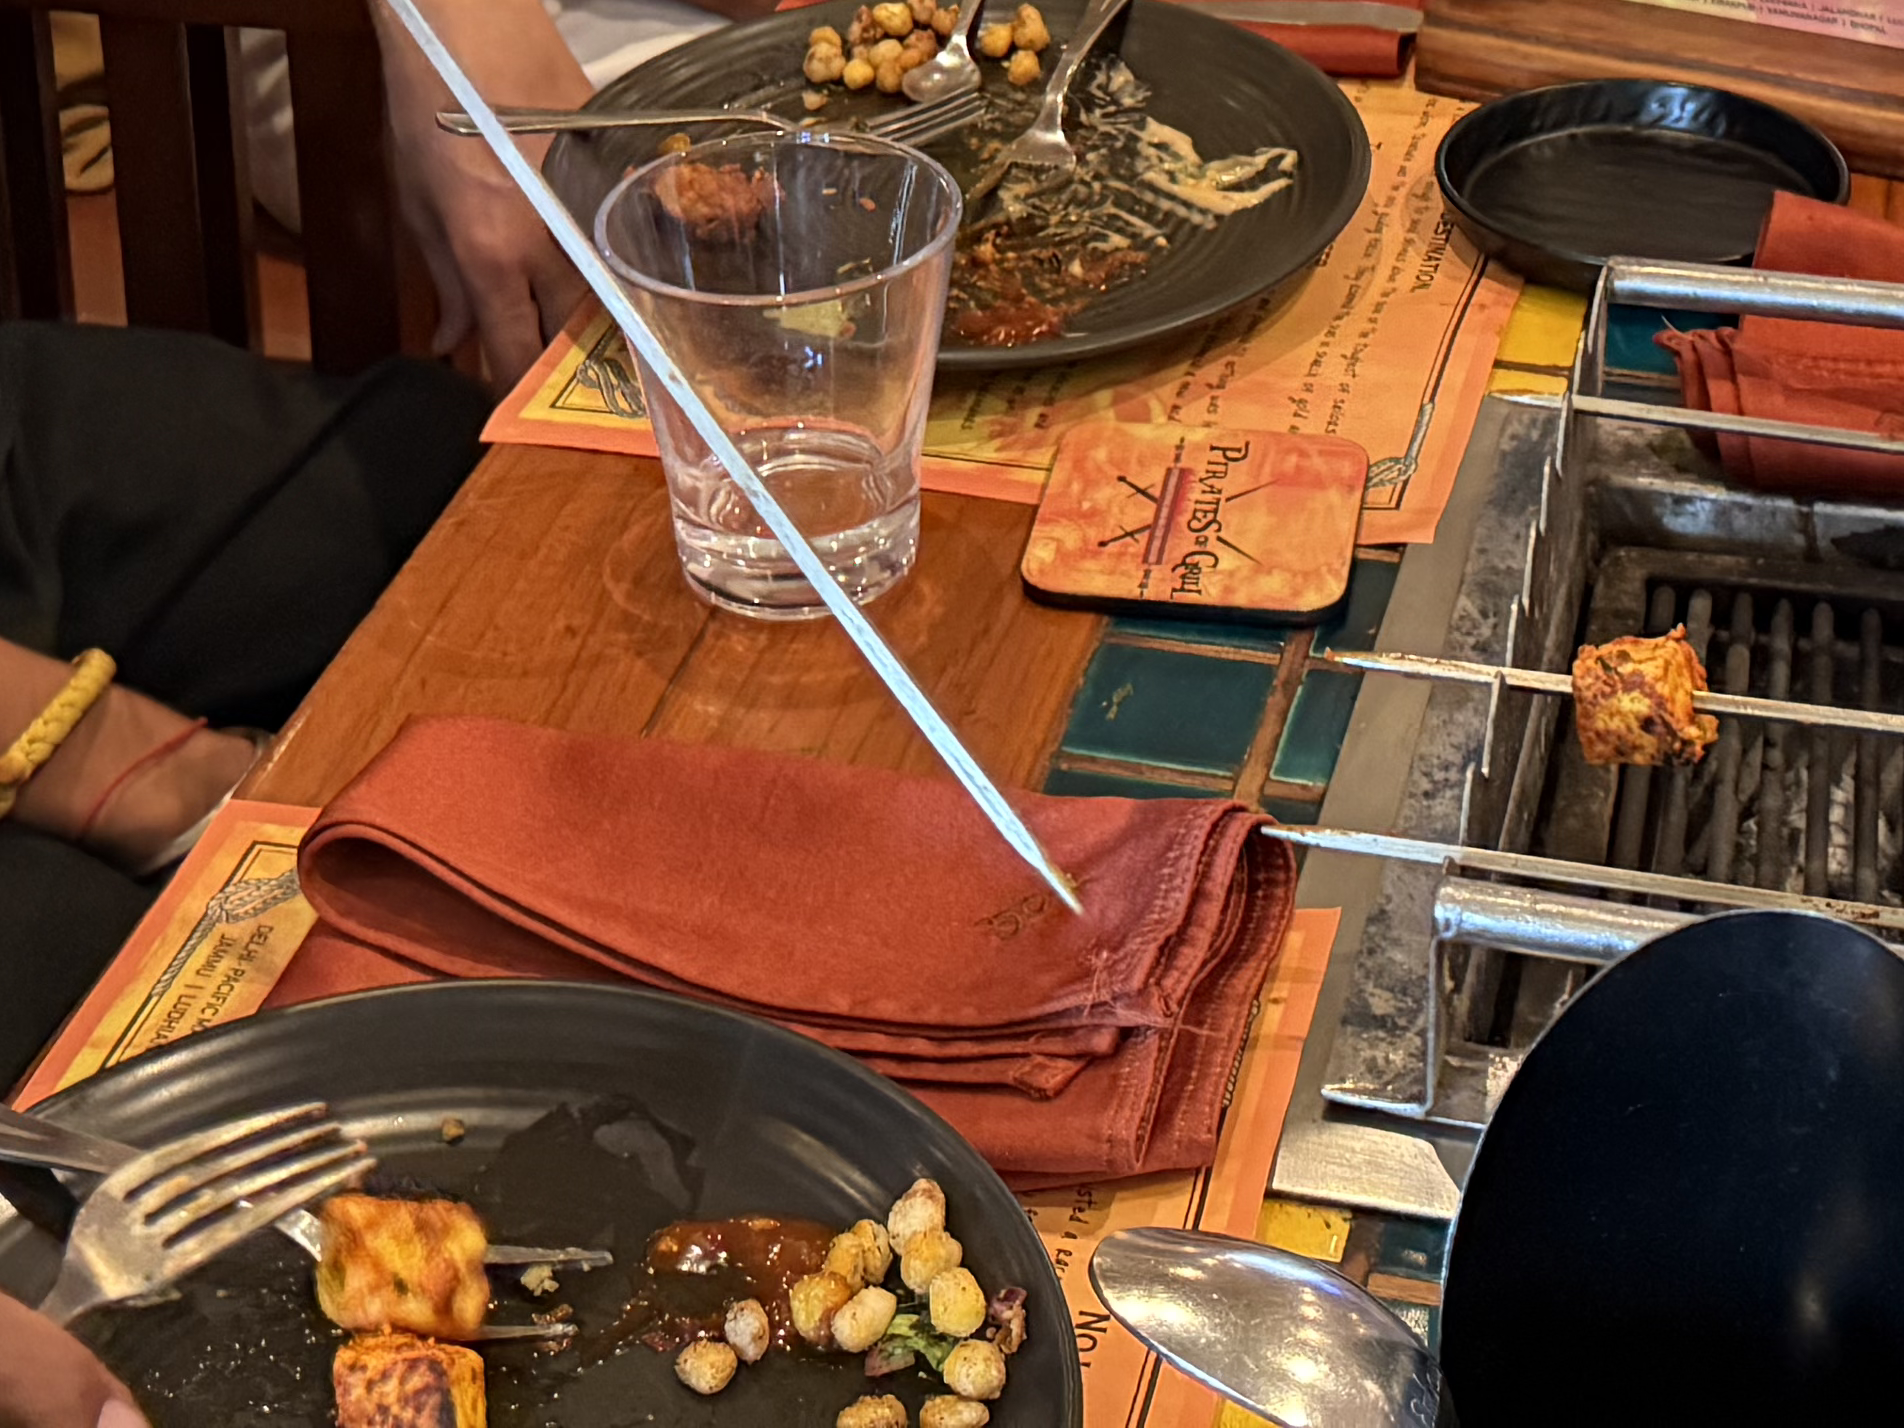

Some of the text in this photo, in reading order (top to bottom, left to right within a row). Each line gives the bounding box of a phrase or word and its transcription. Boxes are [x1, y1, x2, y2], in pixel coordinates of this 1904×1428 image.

[1186, 441, 1250, 533] PIRATES
[1171, 550, 1219, 599] GRILL
[149, 933, 237, 1045] JAMMU LUDHIA
